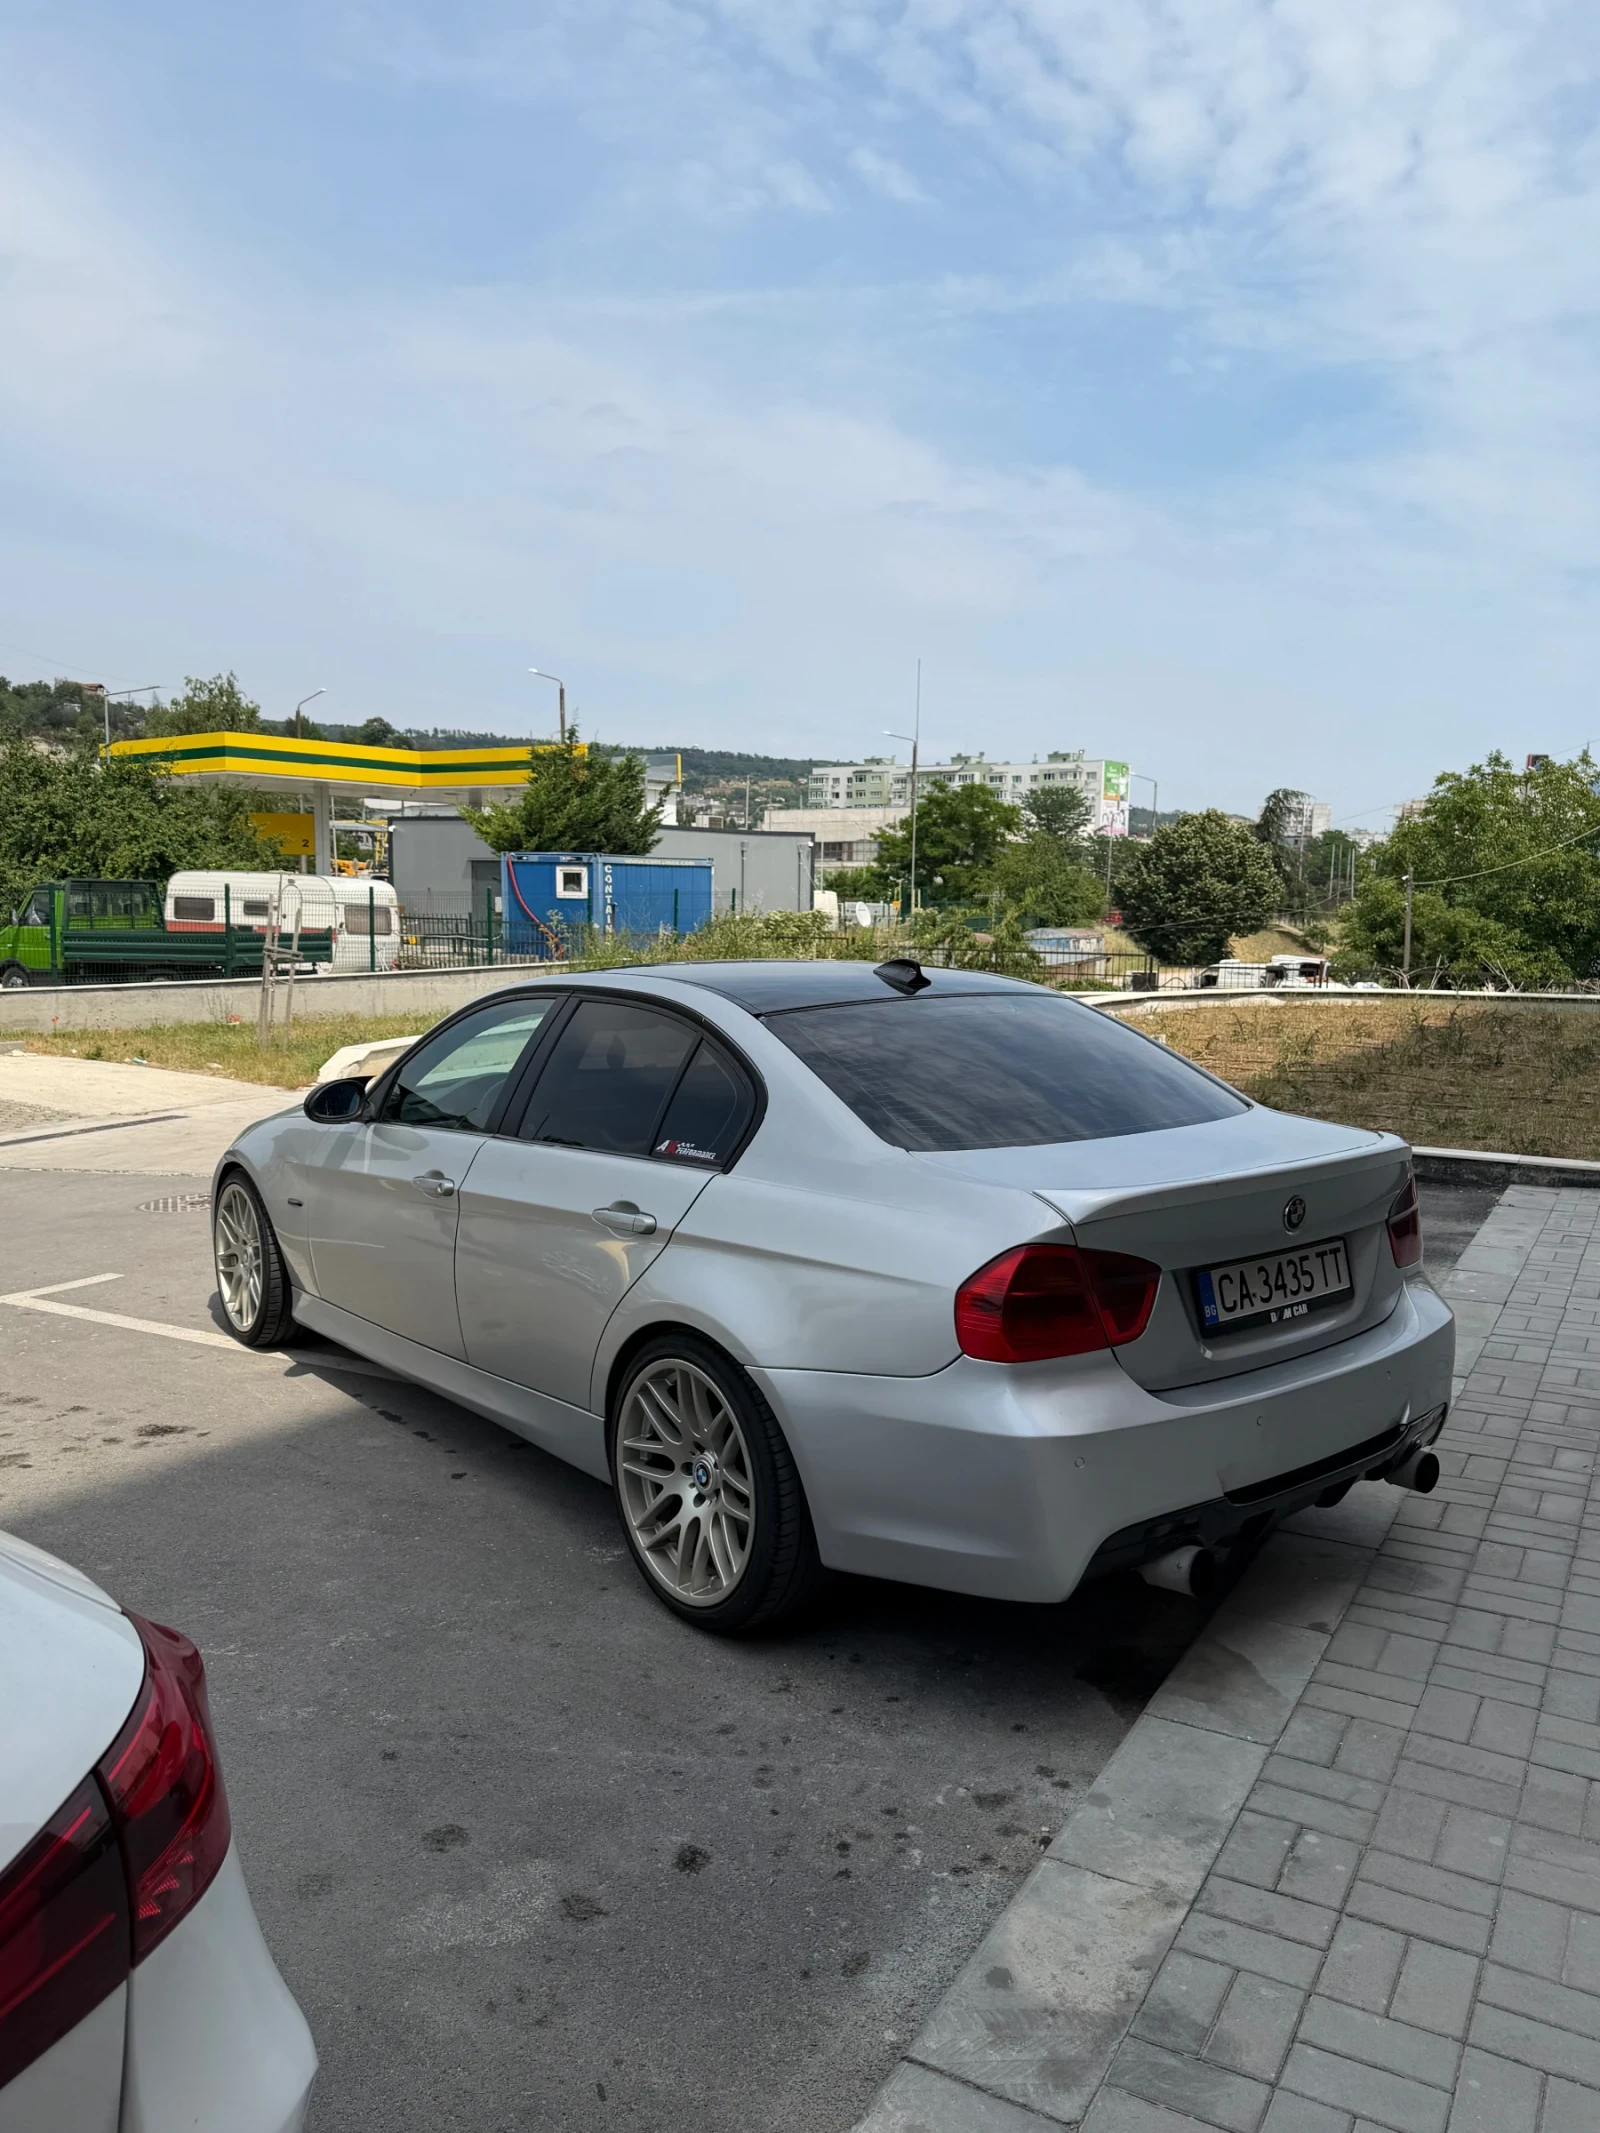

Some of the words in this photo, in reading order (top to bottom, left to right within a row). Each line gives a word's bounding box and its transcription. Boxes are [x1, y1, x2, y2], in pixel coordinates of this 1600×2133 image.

[302, 839, 309, 848] 2
[604, 864, 613, 943] CONTAIN
[1204, 1305, 1217, 1318] BG
